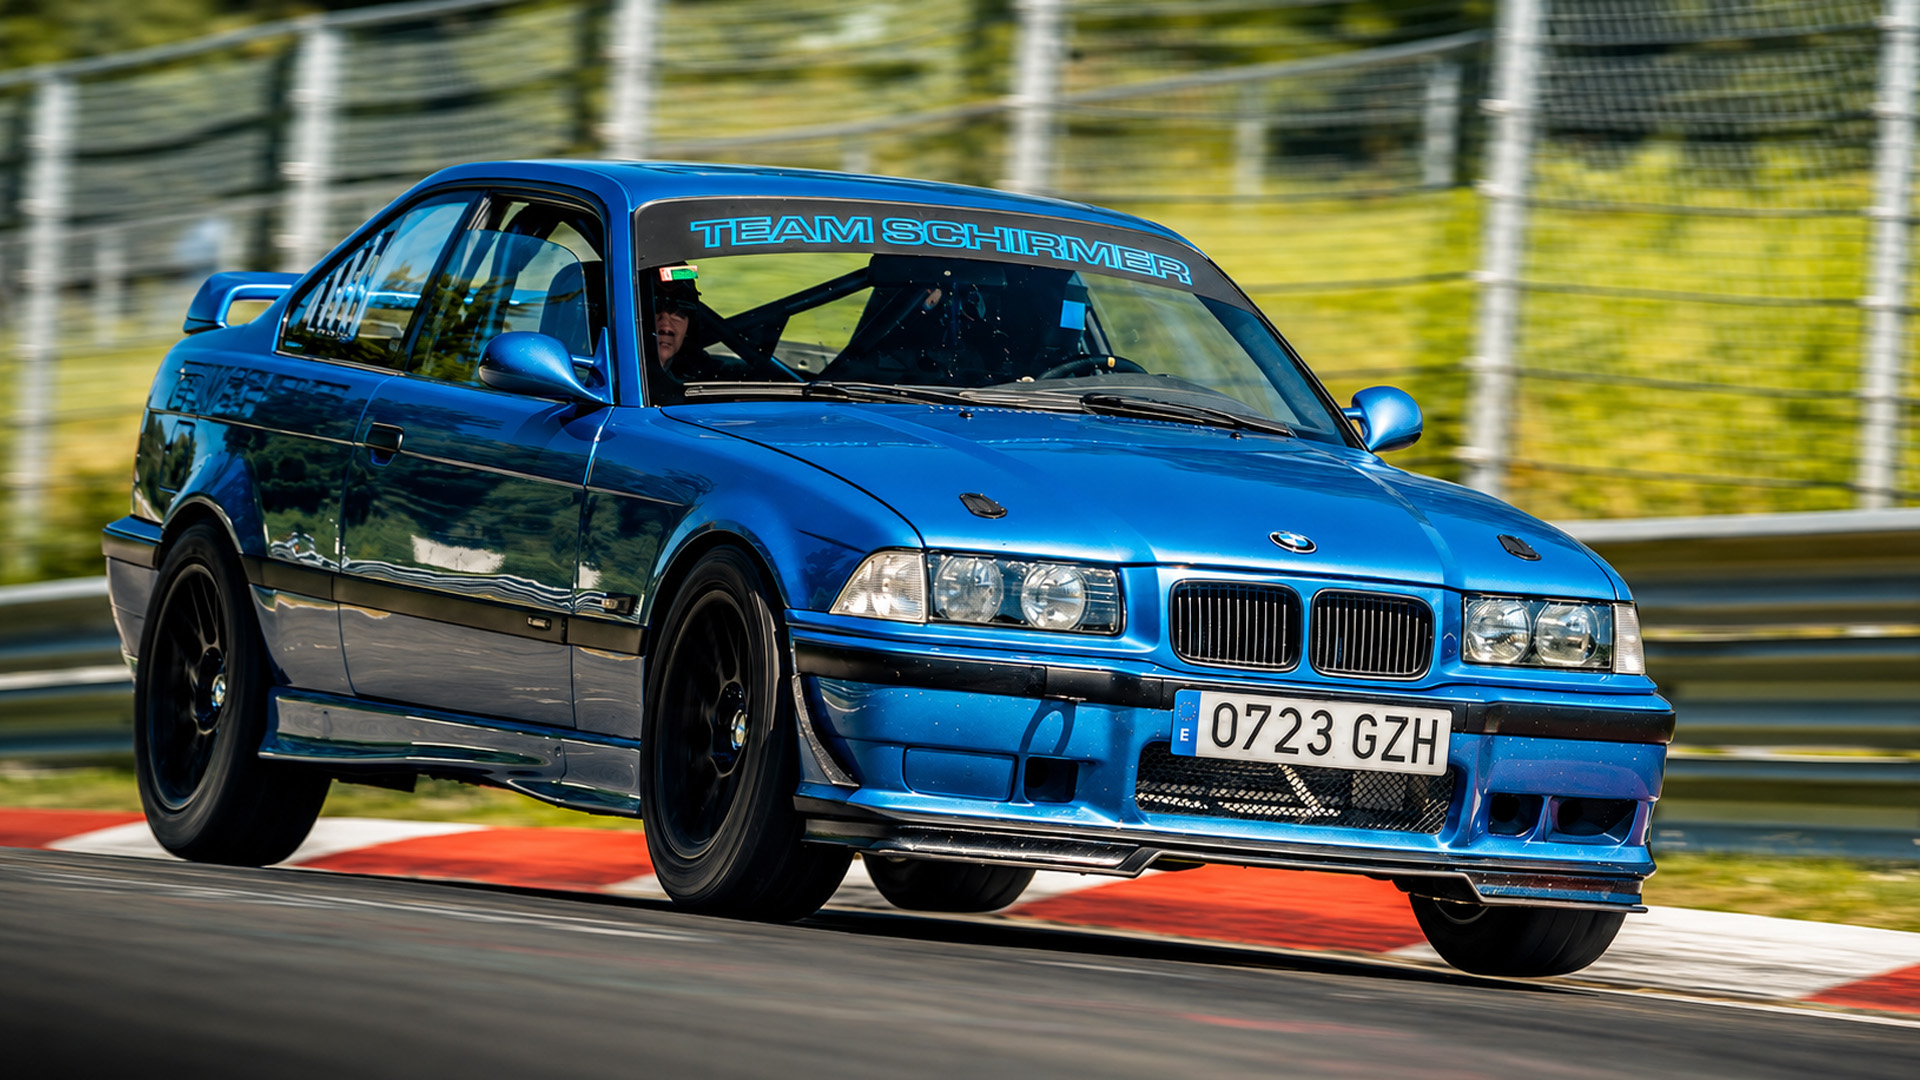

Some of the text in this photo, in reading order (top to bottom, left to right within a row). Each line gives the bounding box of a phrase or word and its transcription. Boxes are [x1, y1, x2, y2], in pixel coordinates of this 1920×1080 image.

[690, 215, 1193, 286] TEAM SCHIRMER
[1180, 728, 1190, 742] E
[1211, 702, 1438, 765] 0723 GZH
